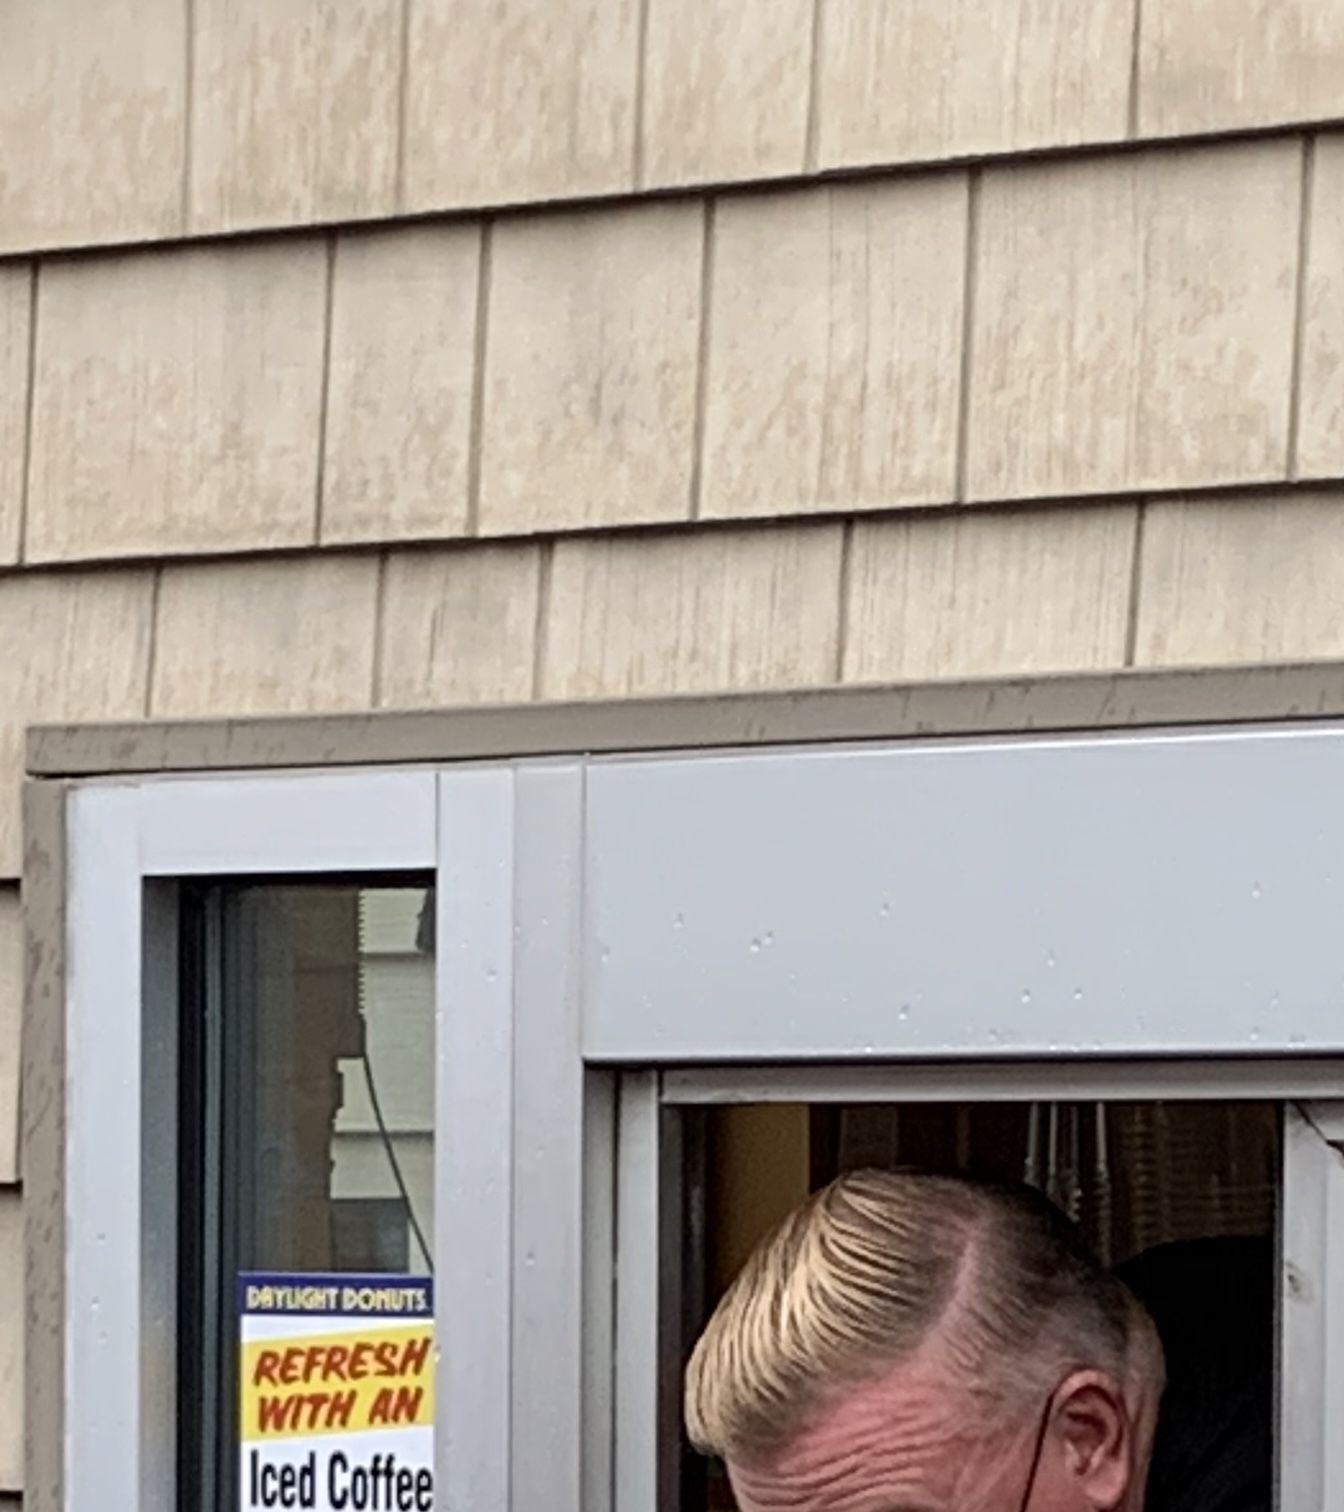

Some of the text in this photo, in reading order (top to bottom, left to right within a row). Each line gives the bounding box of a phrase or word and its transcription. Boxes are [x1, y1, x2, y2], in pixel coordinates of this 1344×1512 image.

[246, 1285, 427, 1312] DAYLIGHT DONUTS
[253, 1337, 433, 1387] REFRESH
[258, 1386, 425, 1433] WITH AN
[250, 1448, 317, 1510] Iced
